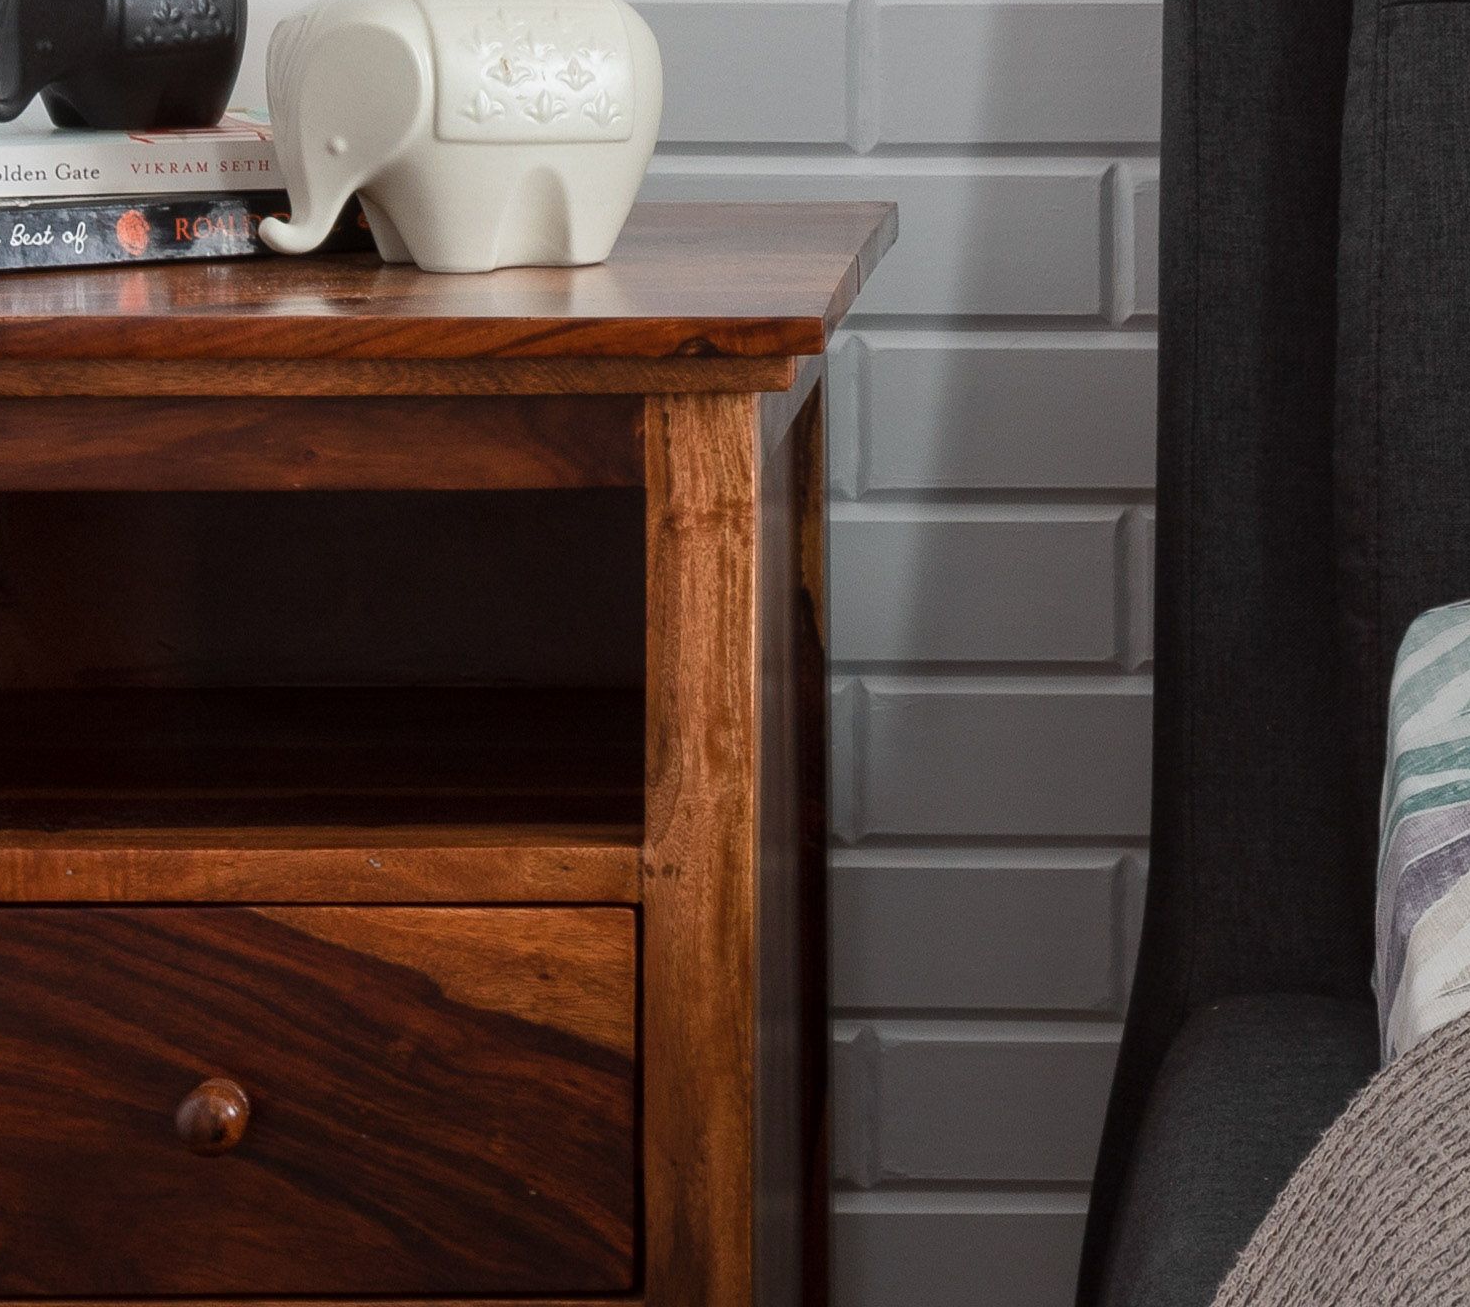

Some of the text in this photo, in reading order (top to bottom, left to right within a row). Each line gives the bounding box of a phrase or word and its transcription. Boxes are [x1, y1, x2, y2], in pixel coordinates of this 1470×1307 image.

[55, 163, 100, 180] Gate
[131, 162, 209, 174] VIKRAM
[220, 160, 270, 172] SETH
[10, 224, 54, 246] Best
[62, 221, 88, 254] of
